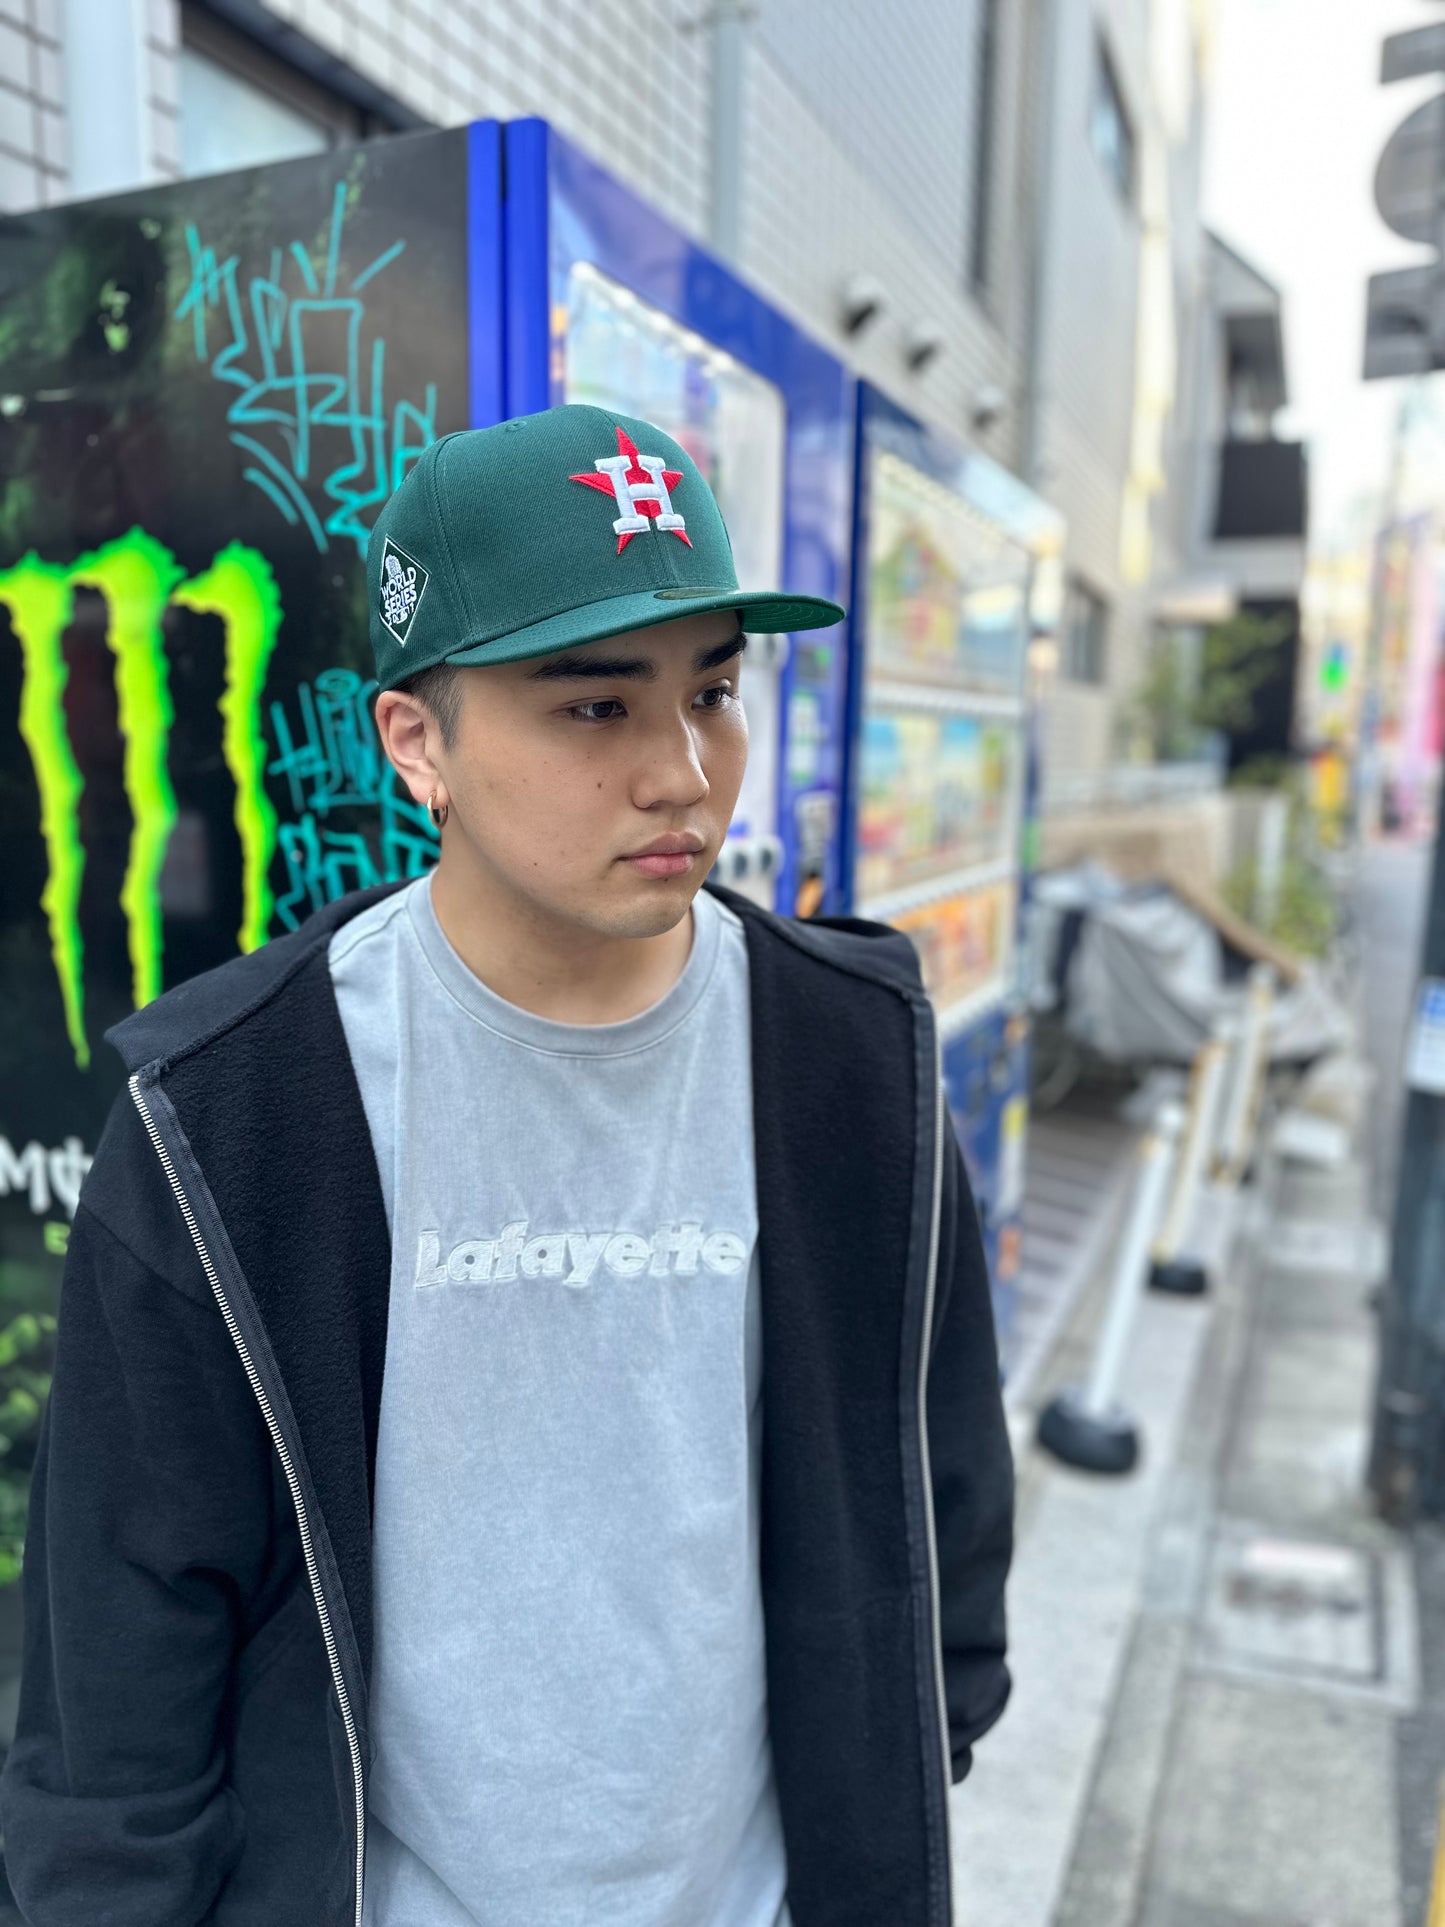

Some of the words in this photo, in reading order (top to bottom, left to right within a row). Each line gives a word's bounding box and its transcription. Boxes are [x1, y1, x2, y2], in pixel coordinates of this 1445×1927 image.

[594, 454, 686, 535] H
[381, 566, 417, 601] WORLD
[384, 584, 417, 615] SERIES
[415, 1221, 747, 1288] Lafayette
